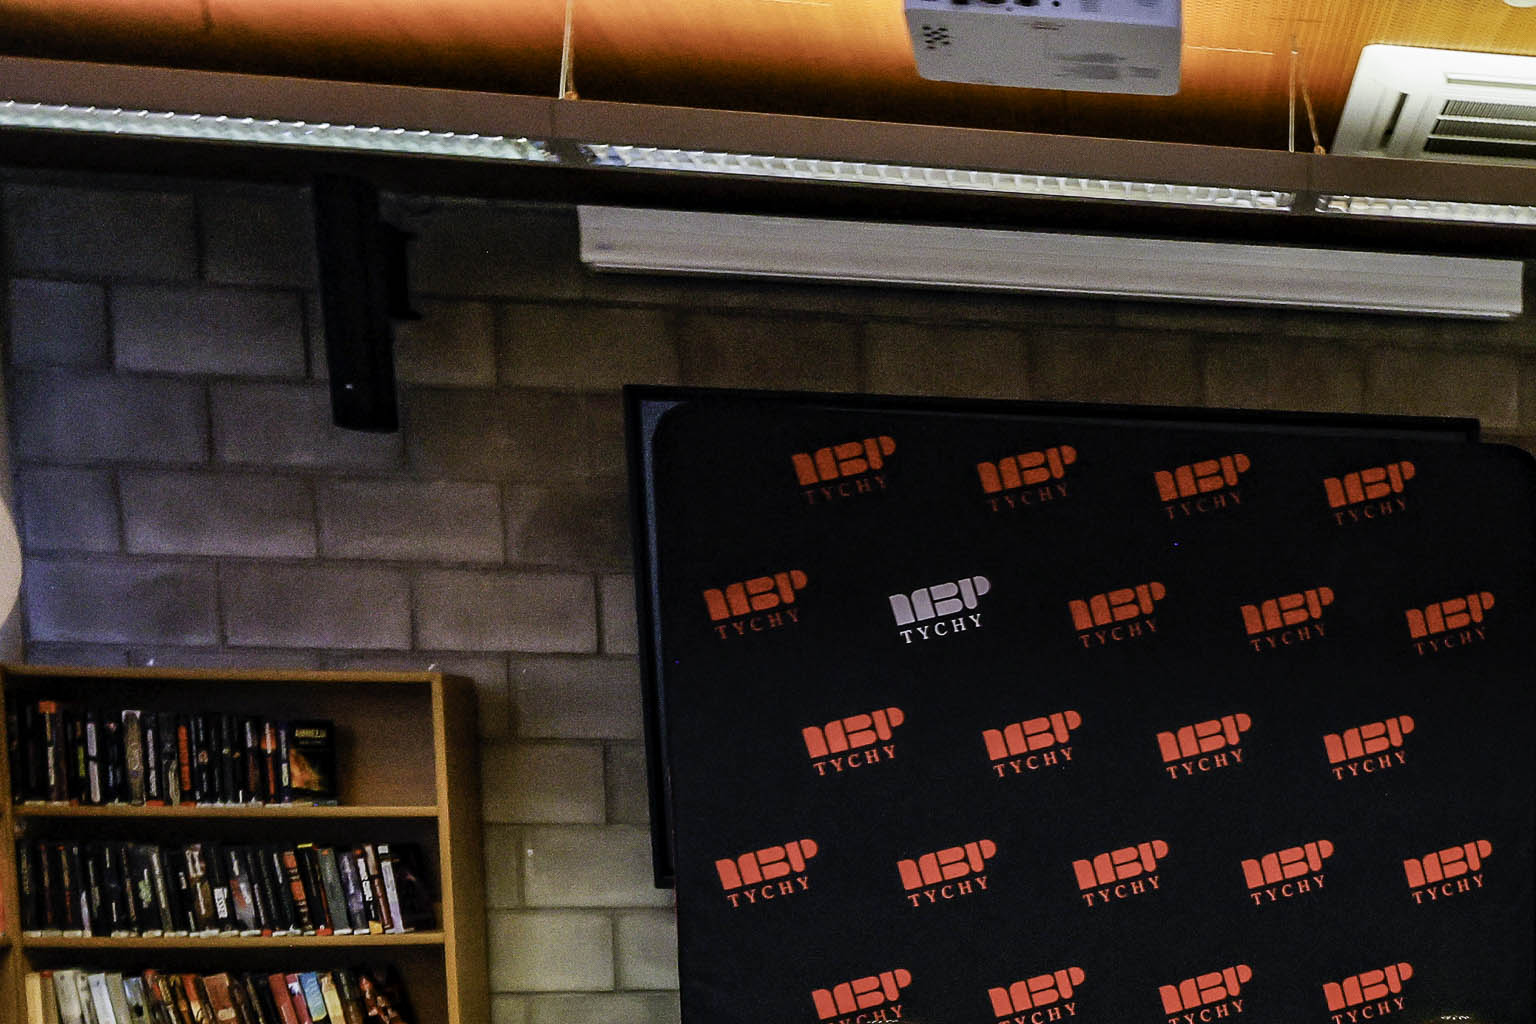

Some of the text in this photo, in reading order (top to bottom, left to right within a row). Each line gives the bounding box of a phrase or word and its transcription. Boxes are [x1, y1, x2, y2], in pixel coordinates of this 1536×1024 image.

[807, 476, 885, 503] TYCHY
[991, 485, 1066, 511] TYCHY
[1167, 493, 1240, 519] TYCHY
[1336, 499, 1405, 525] TYCHY
[715, 610, 798, 639] TYCHY
[900, 614, 980, 643] TYCHY
[1080, 620, 1155, 648] TYCHY
[1250, 624, 1324, 652] TYCHY
[1415, 629, 1485, 655] TYCHY
[813, 745, 894, 776] TYCHY
[993, 747, 1071, 777] TYCHY
[1166, 749, 1242, 779] TYCHY
[1333, 751, 1405, 780] TYCHY
[727, 876, 808, 907] TYCHY
[908, 876, 987, 907] TYCHY
[1083, 876, 1159, 906] TYCHY
[1251, 875, 1324, 905] TYCHY
[1412, 874, 1482, 904] TYCHY
